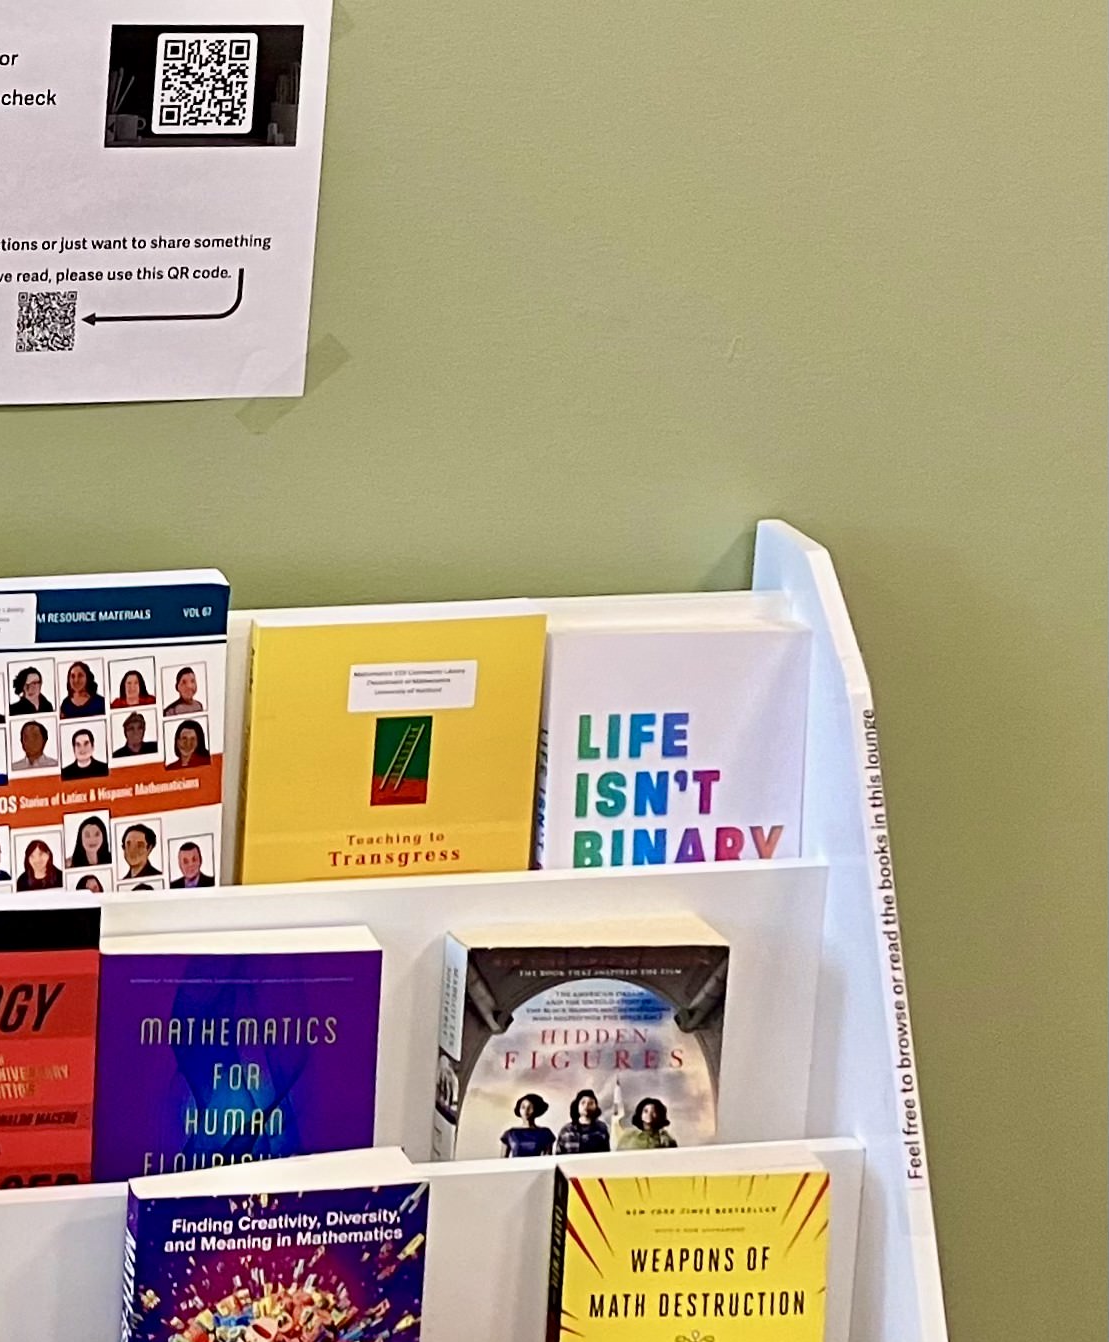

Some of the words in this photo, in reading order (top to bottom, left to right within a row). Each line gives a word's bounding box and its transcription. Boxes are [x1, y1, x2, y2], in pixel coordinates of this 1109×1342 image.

[0, 87, 57, 106] check
[40, 238, 57, 253] or
[57, 236, 89, 255] just
[90, 236, 128, 250] want
[130, 236, 147, 250] to
[149, 234, 191, 249] share
[193, 233, 271, 251] something
[15, 267, 52, 284] read,
[55, 267, 104, 285] please
[106, 269, 133, 281] use
[135, 265, 164, 280] this
[166, 265, 190, 280] QR
[191, 264, 232, 279] code.
[47, 608, 99, 623] RESOURCE
[97, 608, 151, 621] MATERIALS
[578, 713, 689, 760] LIFE
[575, 770, 720, 818] ISN'T
[347, 832, 422, 846] Teaching
[428, 831, 445, 842] to
[573, 825, 784, 868] BINARY
[327, 848, 460, 868] Transgress
[141, 1017, 338, 1046] MATHEMATICS
[541, 1028, 650, 1046] HIDDEN
[504, 1049, 684, 1071] FIGURES
[213, 1063, 260, 1091] FOR
[185, 1108, 283, 1136] HUMAN
[170, 1216, 234, 1235] Finding
[237, 1212, 321, 1231] Creativity,
[325, 1208, 401, 1226] Diversity,
[163, 1236, 196, 1252] and
[199, 1233, 272, 1252] Meaning
[275, 1232, 292, 1247] in
[295, 1225, 403, 1246] Mathematics
[630, 1246, 734, 1273] WEAPONS
[746, 1246, 770, 1271] OF
[588, 1292, 646, 1318] MATH
[657, 1290, 805, 1317] DESTRUCTION
